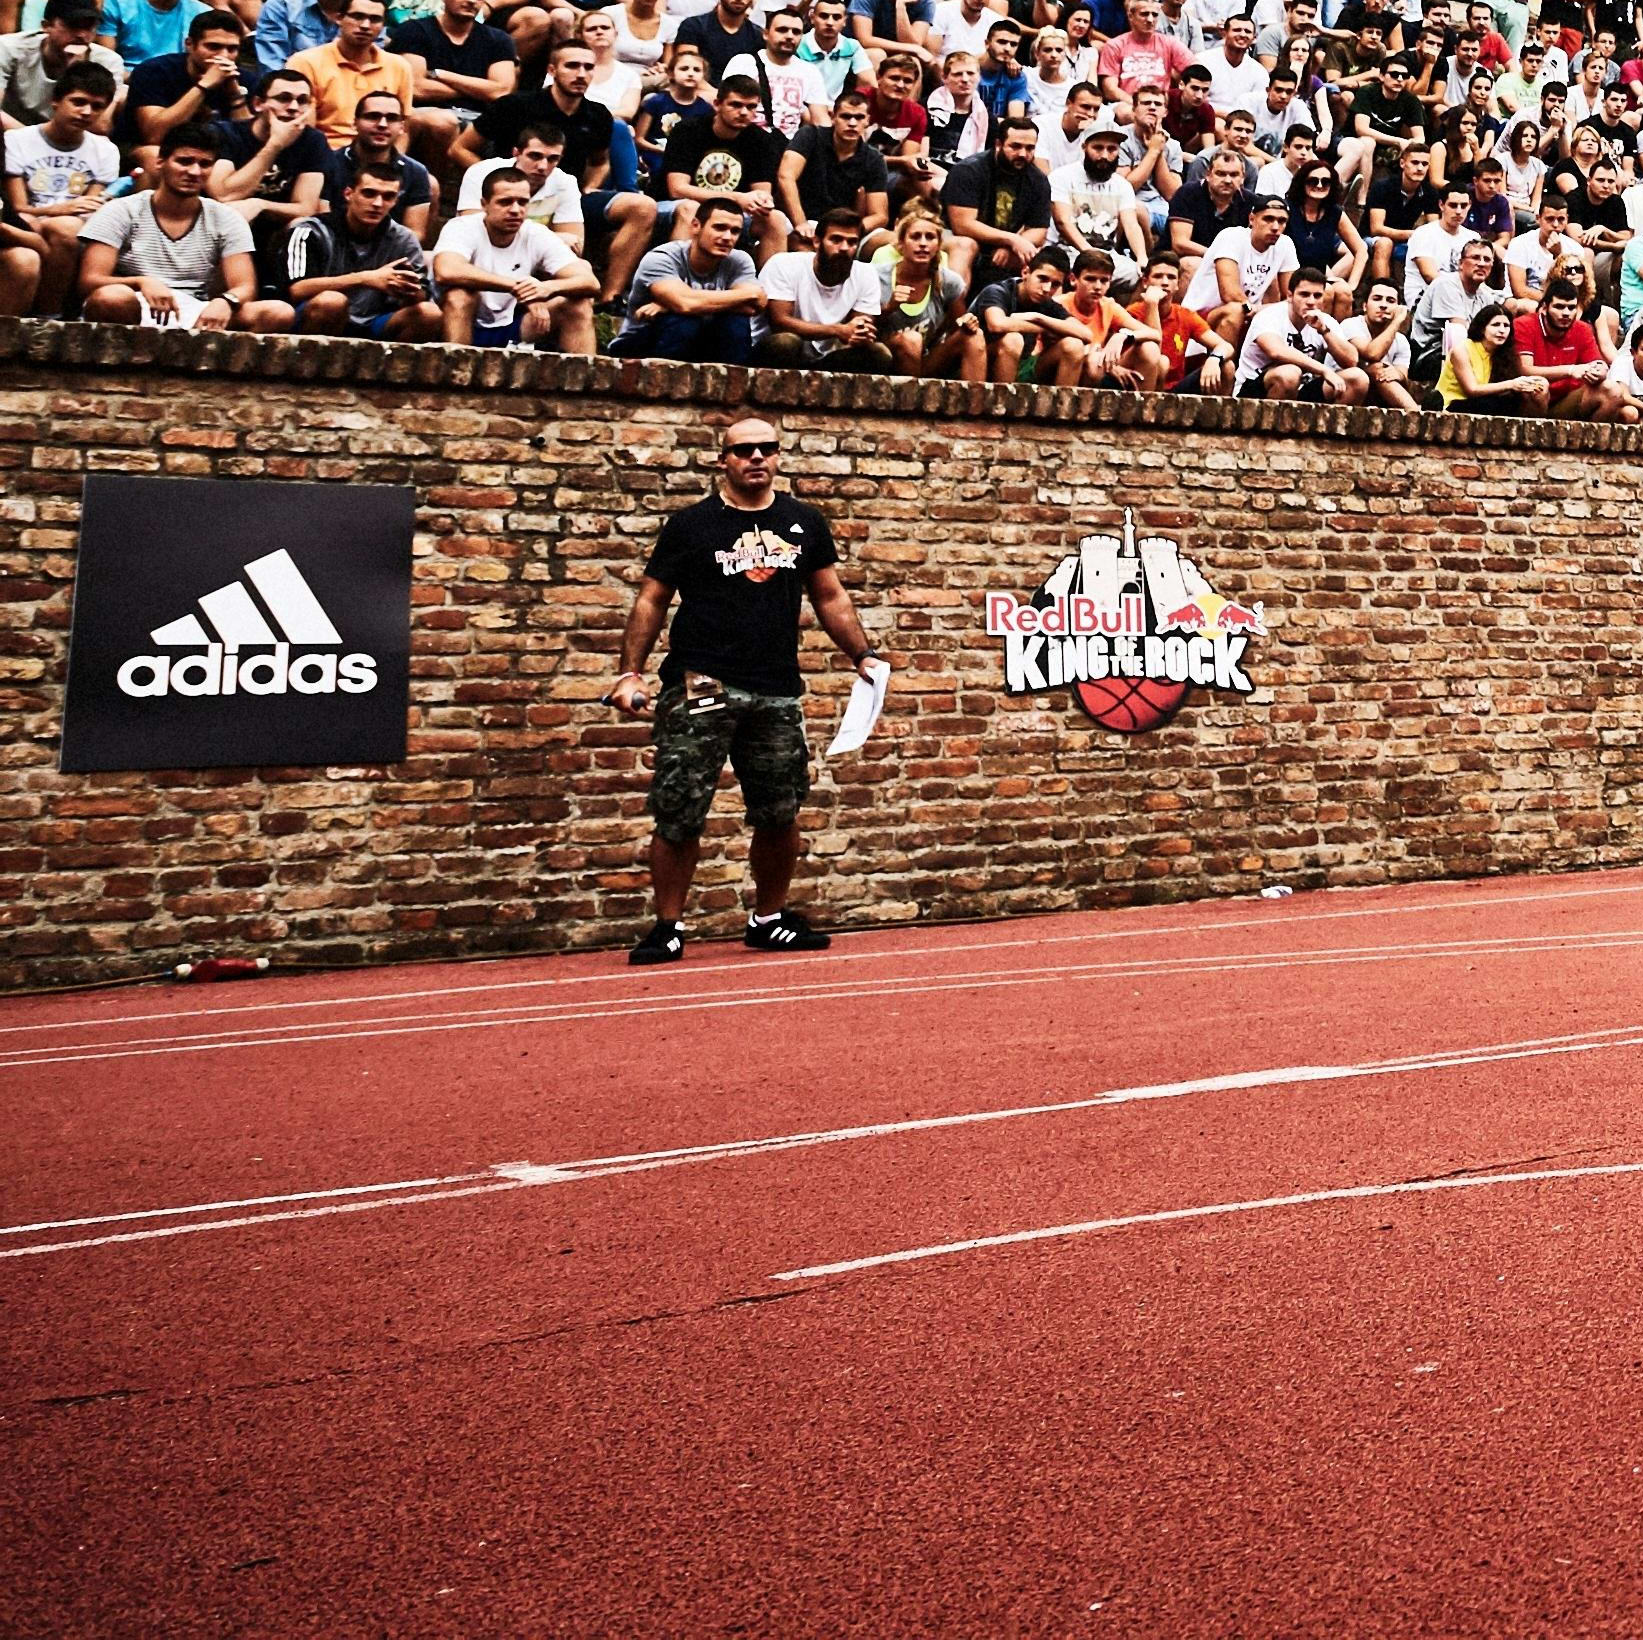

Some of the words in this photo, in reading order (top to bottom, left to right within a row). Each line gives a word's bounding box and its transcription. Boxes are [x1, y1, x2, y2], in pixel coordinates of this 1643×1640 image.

[990, 596, 1065, 631] Red
[1074, 597, 1143, 633] Bull
[1114, 636, 1138, 657] OF
[1145, 634, 1252, 691] ROCK
[117, 642, 378, 697] adidas
[1109, 656, 1145, 677] THE
